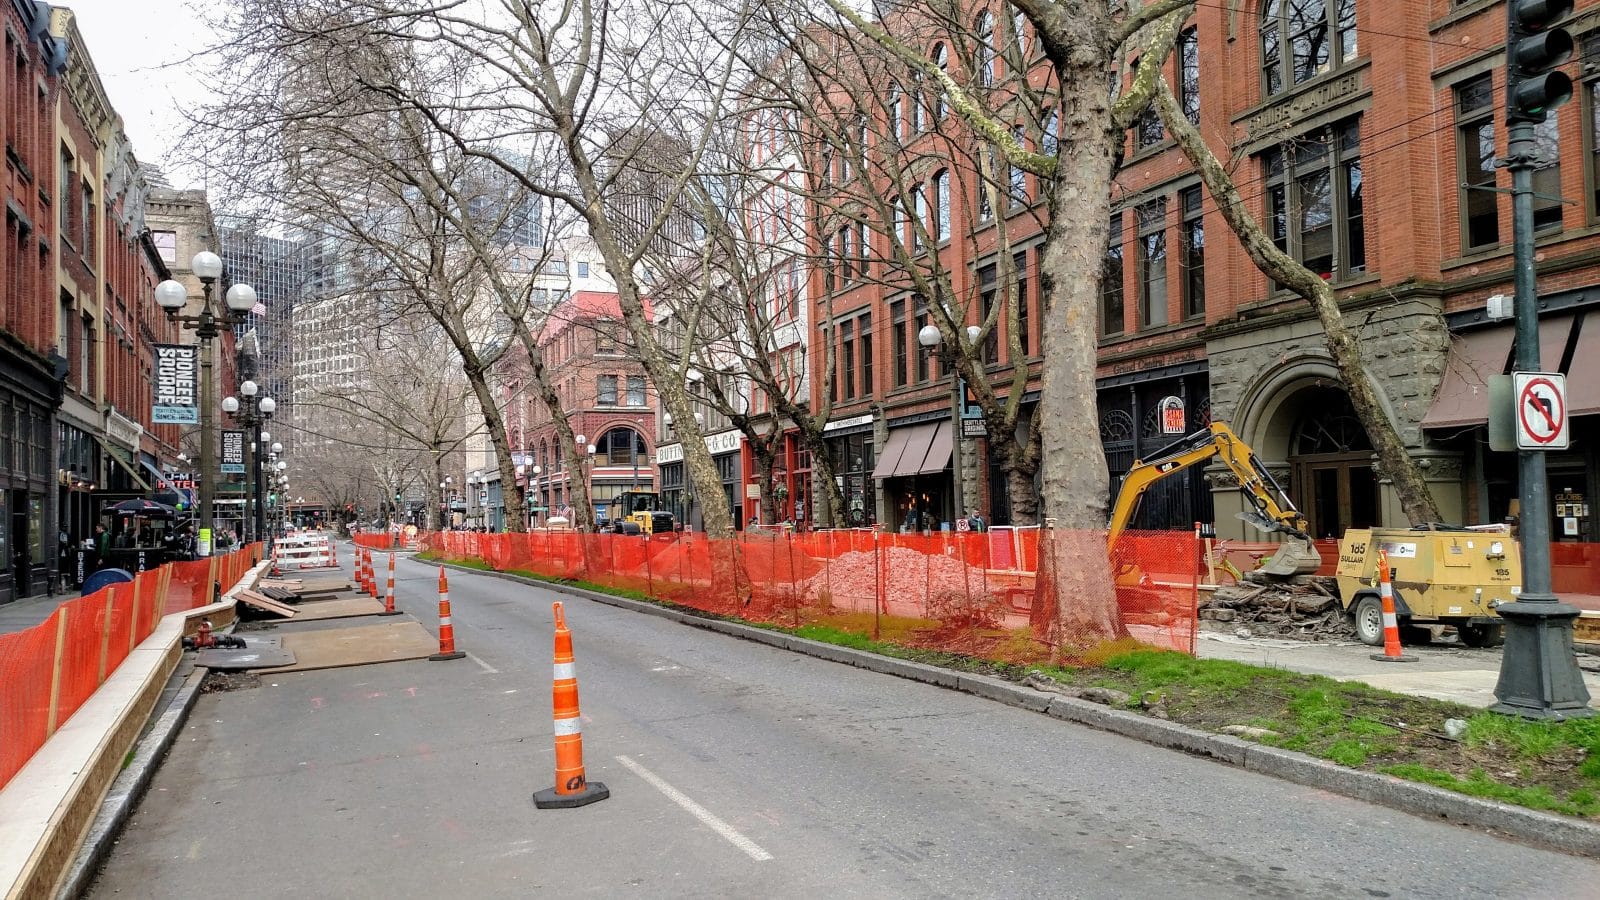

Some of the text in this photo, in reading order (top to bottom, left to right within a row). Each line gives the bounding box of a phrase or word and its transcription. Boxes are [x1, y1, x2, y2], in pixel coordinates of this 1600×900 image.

[1113, 361, 1136, 374] Grand
[1138, 355, 1165, 369] Central
[158, 348, 176, 404] SQUARE
[176, 348, 193, 405] PIONEER
[223, 432, 233, 463] SQUARE
[233, 432, 243, 463] PIONEER
[1161, 462, 1173, 472] CAT
[1350, 542, 1366, 554] 185
[1340, 555, 1364, 563] SULLAIR
[1495, 568, 1510, 576] 185
